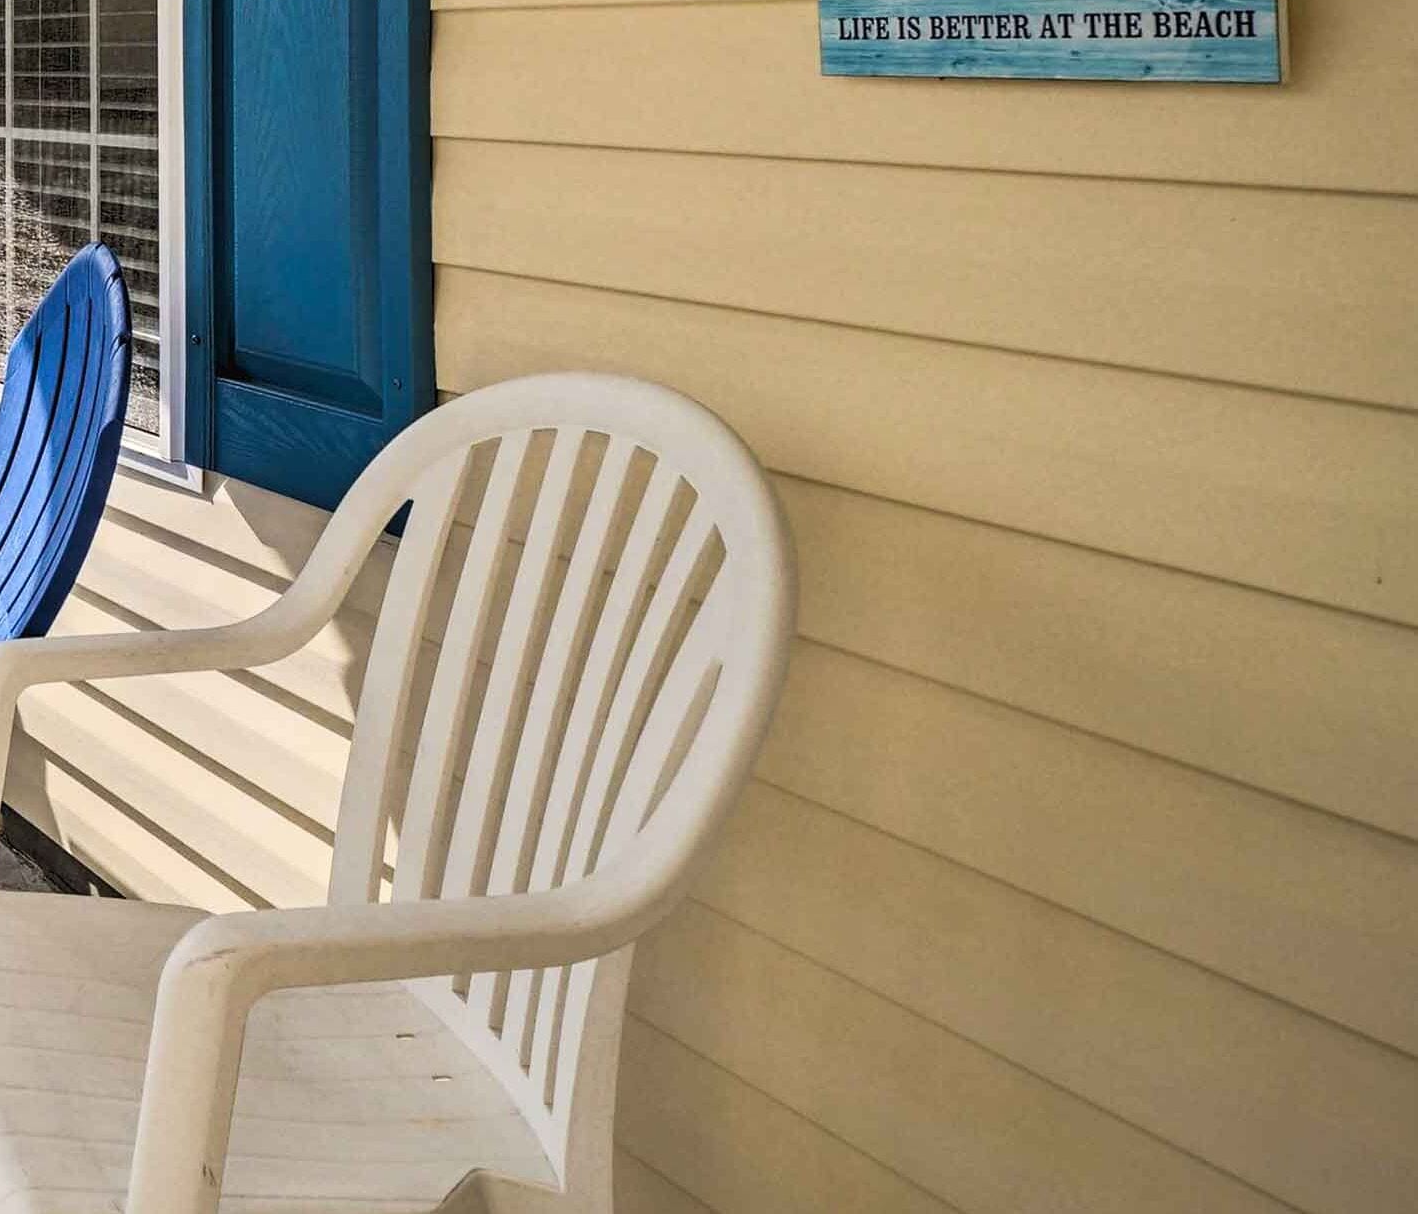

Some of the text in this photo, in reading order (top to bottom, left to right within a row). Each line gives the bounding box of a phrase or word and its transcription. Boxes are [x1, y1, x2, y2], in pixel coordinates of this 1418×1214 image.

[838, 9, 1257, 41] LIFE IS BETTER AT THE BEACH
